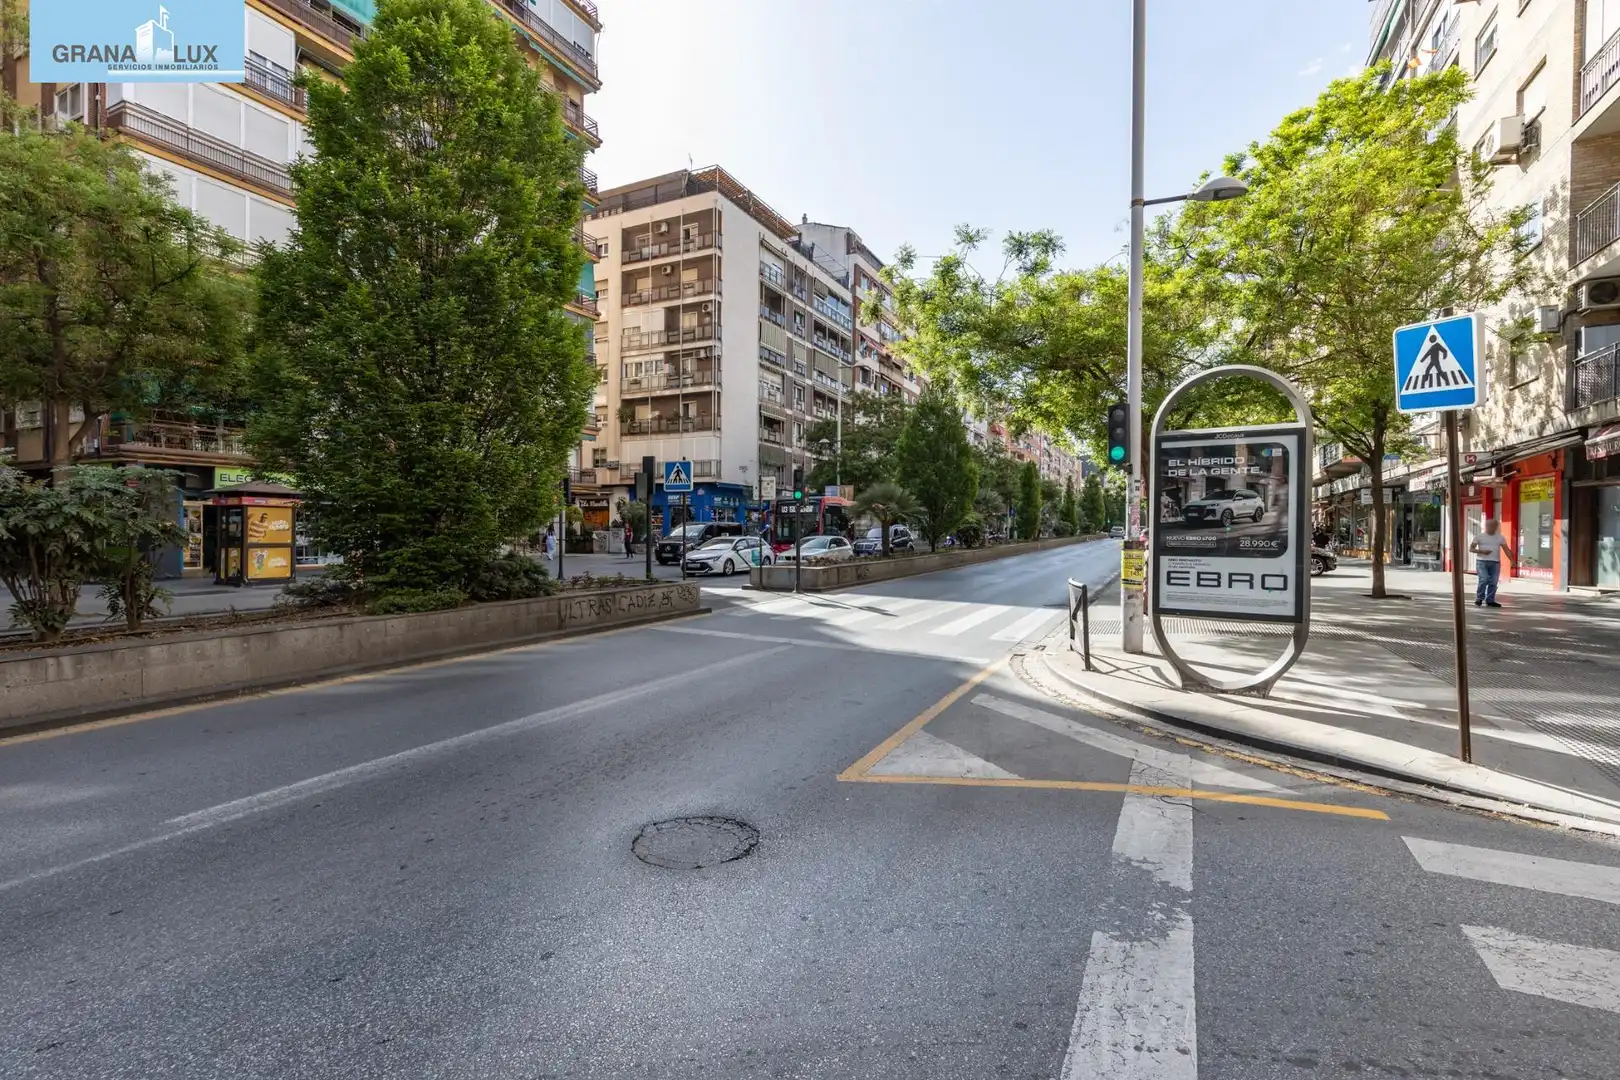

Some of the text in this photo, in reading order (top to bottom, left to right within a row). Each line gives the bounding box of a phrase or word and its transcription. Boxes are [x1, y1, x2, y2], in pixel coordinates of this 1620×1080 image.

[1168, 469, 1186, 477] DE
[1189, 467, 1207, 476] LA
[1166, 570, 1288, 590] EBRO
